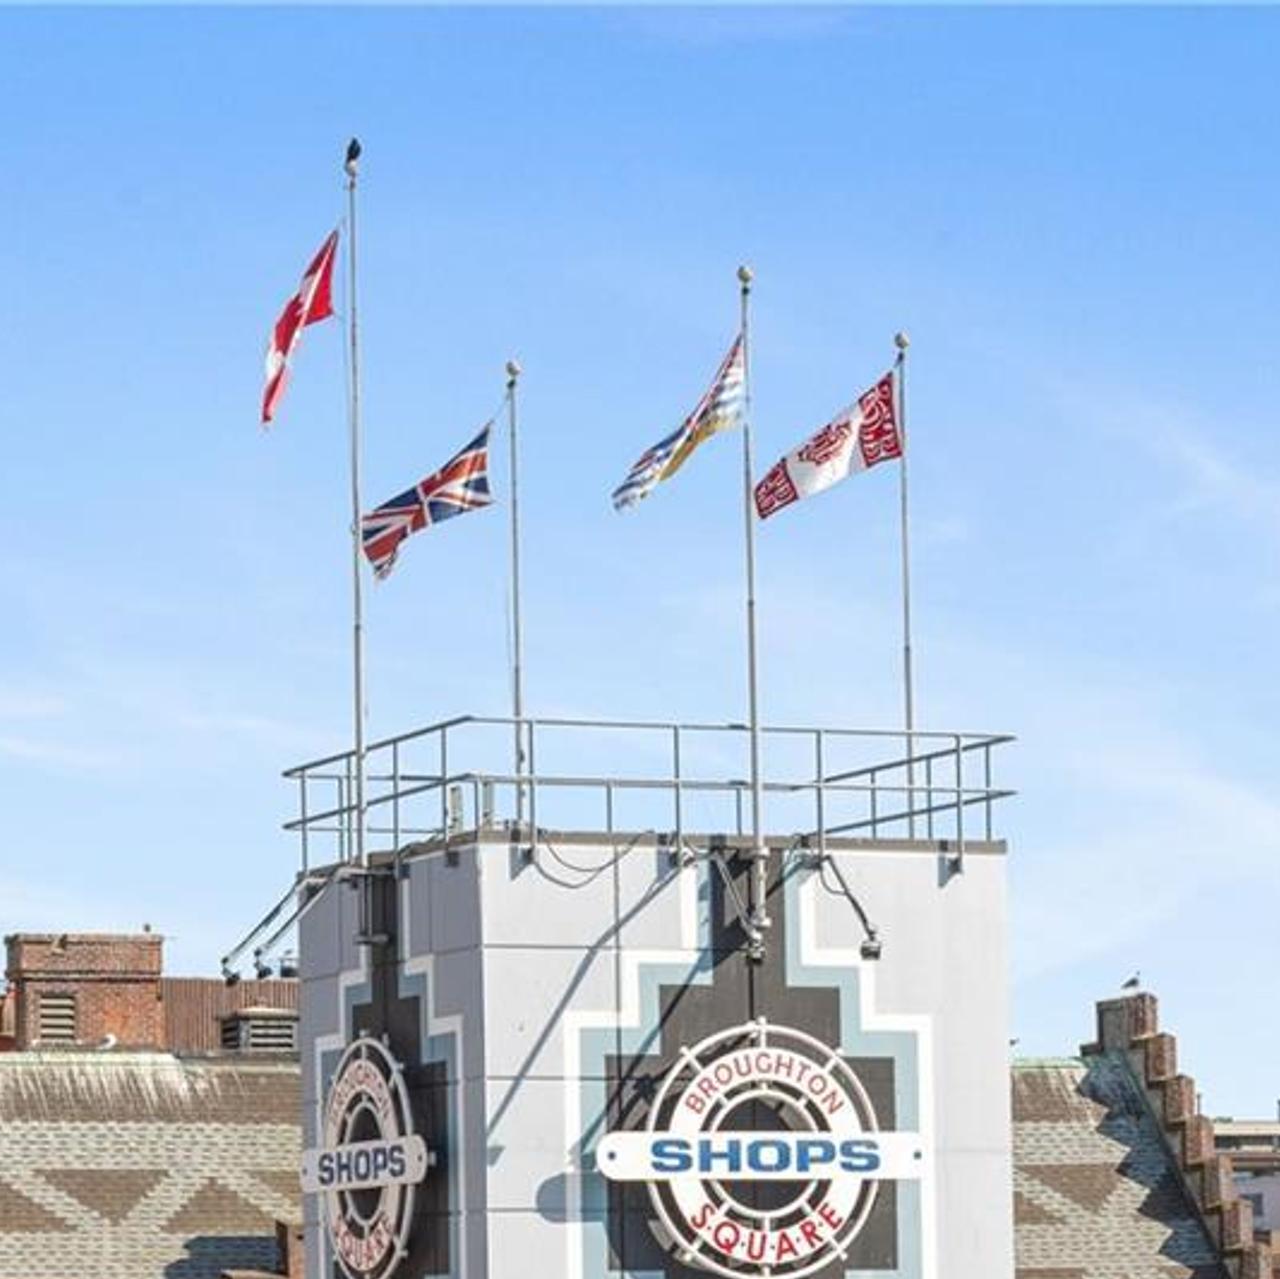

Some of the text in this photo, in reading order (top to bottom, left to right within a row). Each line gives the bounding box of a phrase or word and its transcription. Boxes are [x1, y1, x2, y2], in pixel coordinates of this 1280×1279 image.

[684, 1053, 845, 1115] BROUGHTON
[318, 1144, 406, 1186] SHOPS
[650, 1139, 881, 1173] SHOPS
